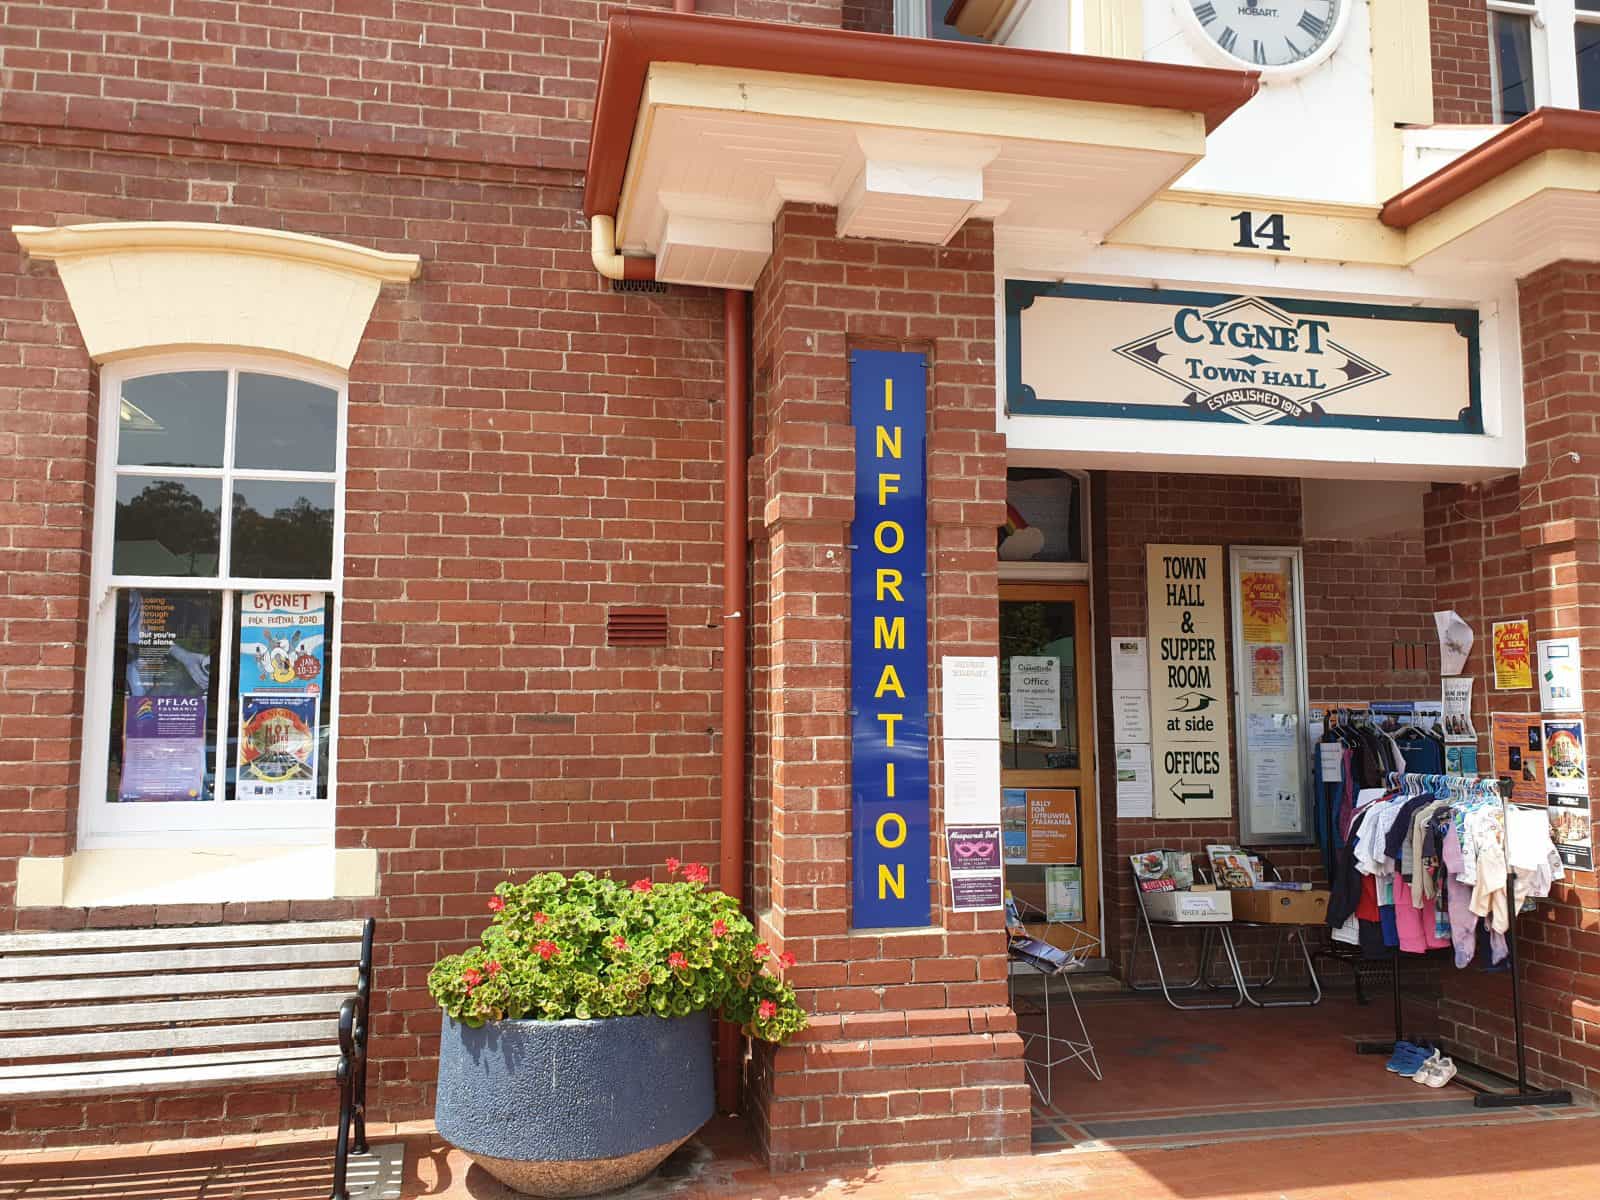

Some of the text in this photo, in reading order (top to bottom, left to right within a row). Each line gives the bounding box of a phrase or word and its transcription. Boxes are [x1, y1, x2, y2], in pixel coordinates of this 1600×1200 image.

[1230, 211, 1291, 251] 14
[1174, 308, 1330, 355] CYGNET
[1185, 358, 1327, 389] TOWN HALL
[1207, 389, 1302, 417] ESTABLISHED 1913
[1163, 557, 1206, 579] TOWN
[254, 593, 311, 610] CYGNET
[1166, 584, 1205, 606] HALL
[1181, 611, 1195, 633] &
[153, 631, 176, 640] you're
[873, 378, 907, 900] INFORMATION
[1161, 638, 1216, 661] SUPPER
[1023, 677, 1049, 686] Office
[1168, 665, 1211, 688] ROOM
[157, 698, 198, 706] PFLAG
[1167, 715, 1214, 731] at side
[1164, 751, 1220, 774] OFFICES
